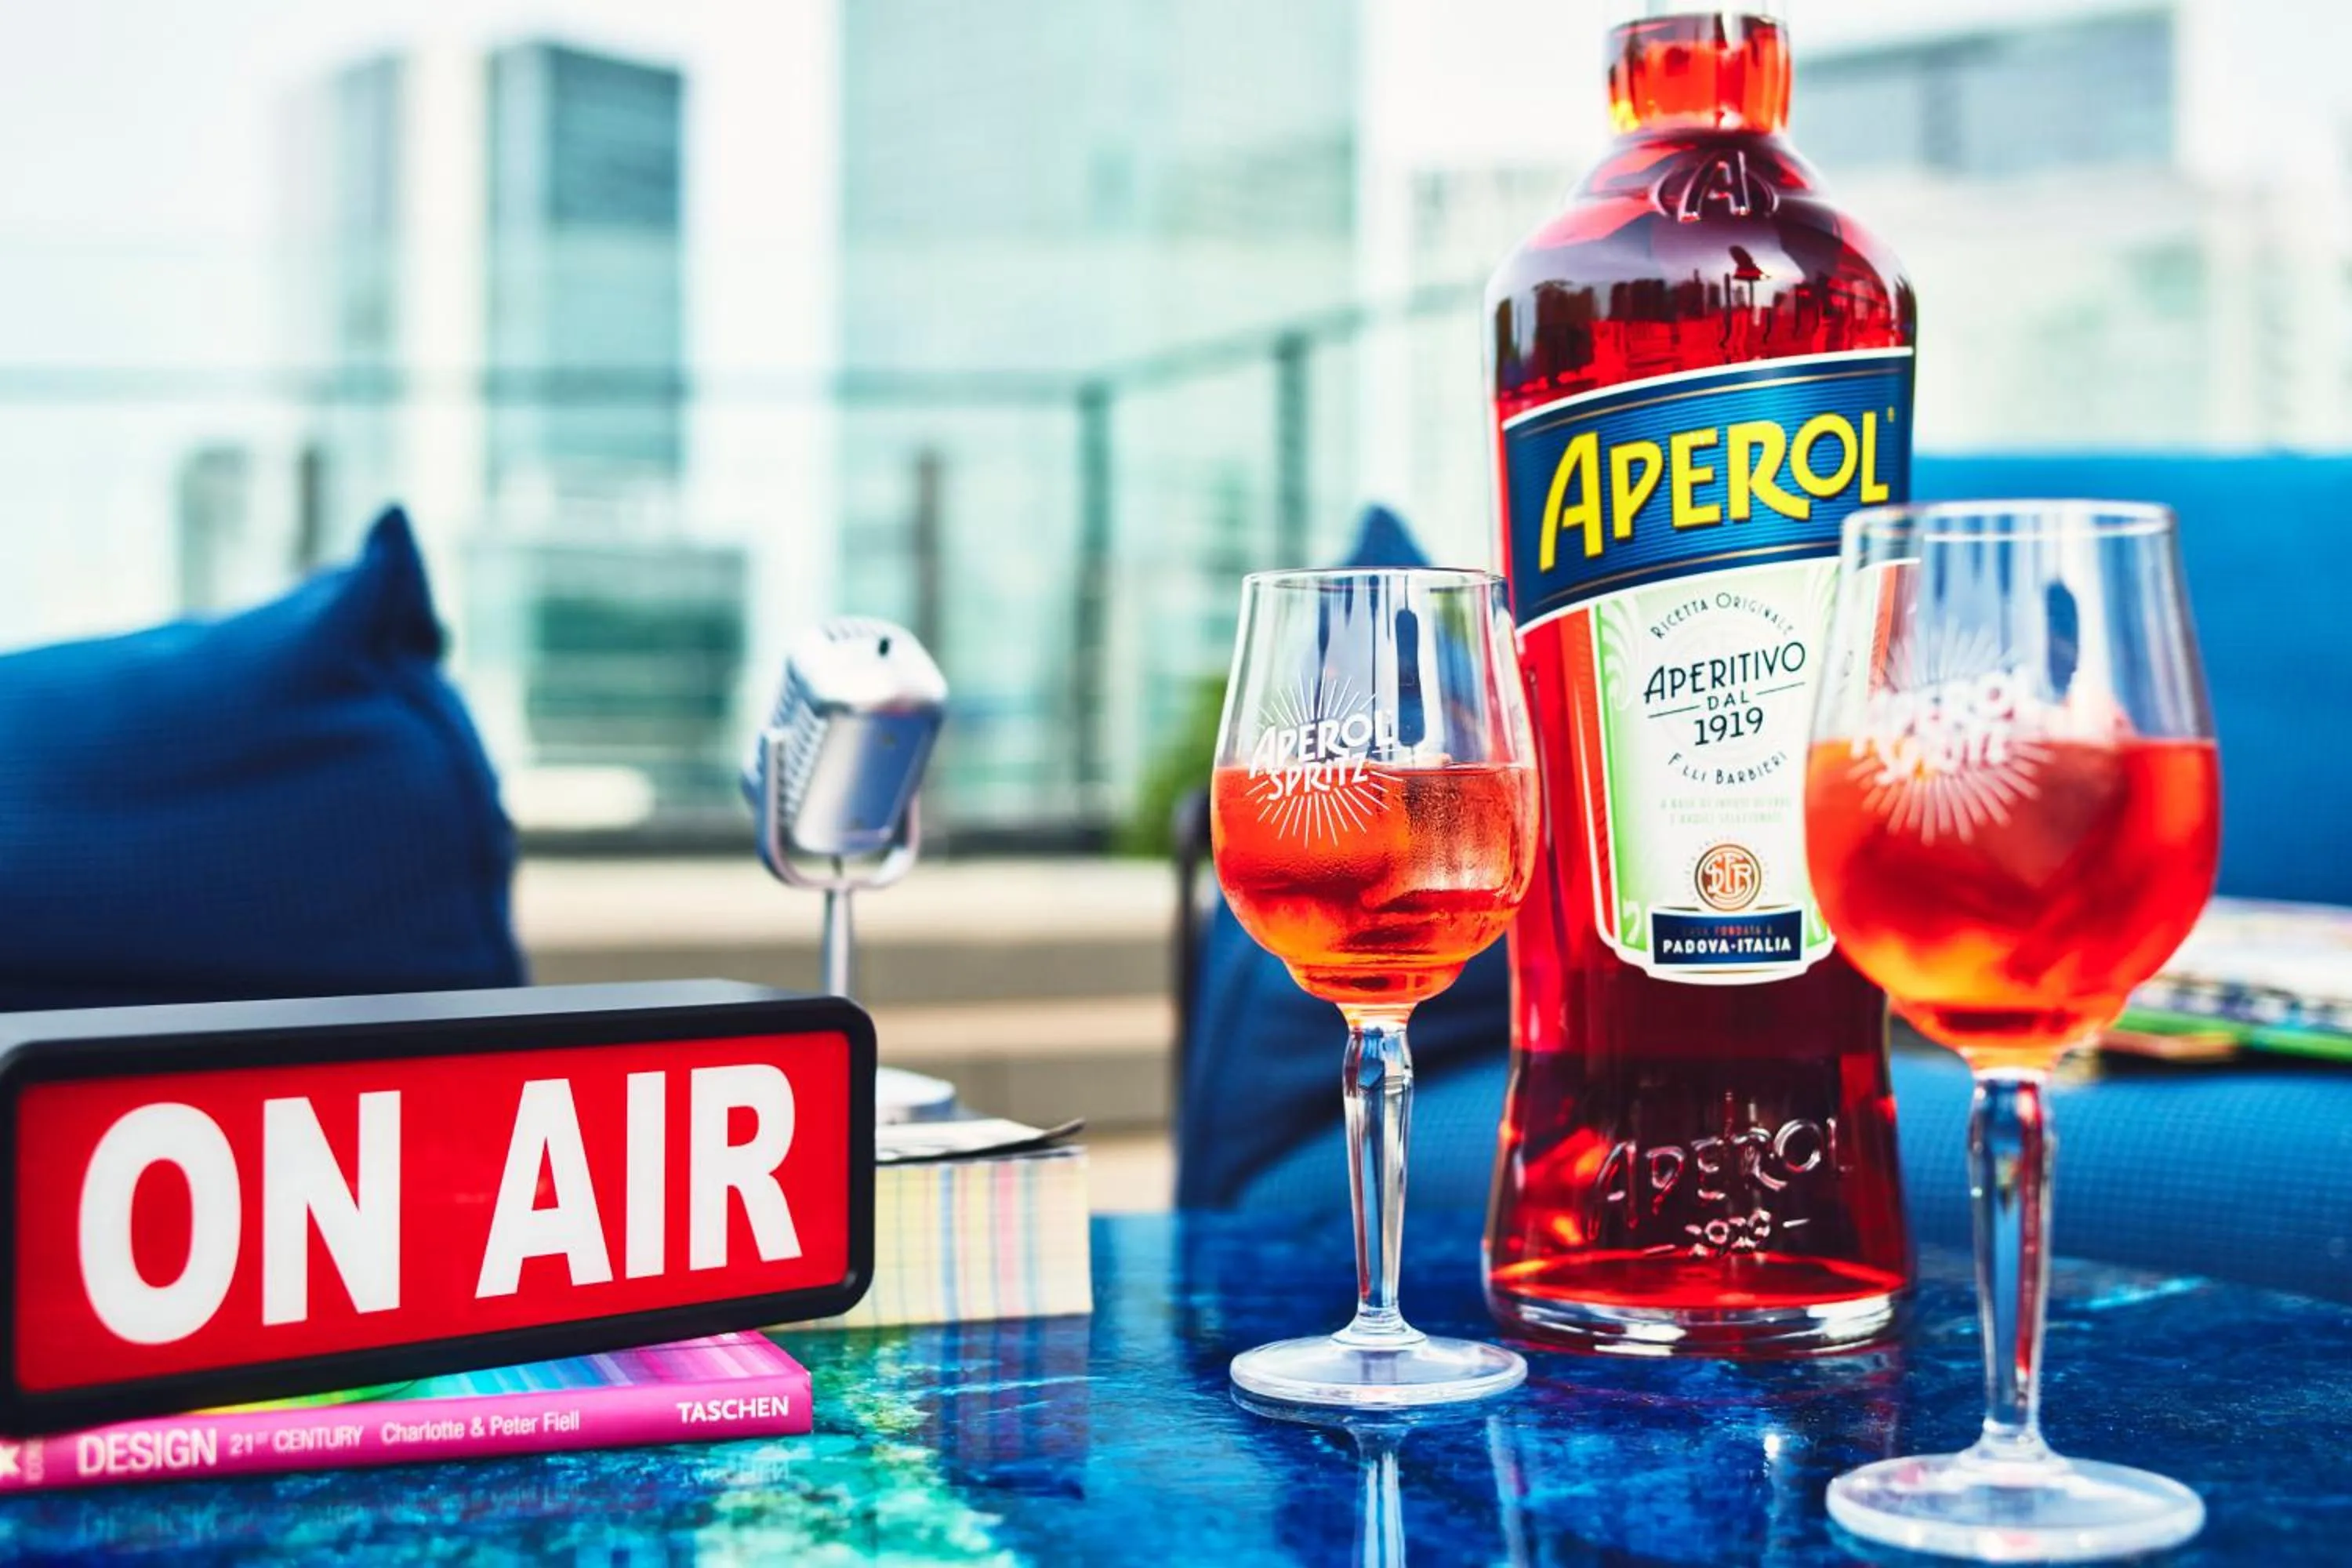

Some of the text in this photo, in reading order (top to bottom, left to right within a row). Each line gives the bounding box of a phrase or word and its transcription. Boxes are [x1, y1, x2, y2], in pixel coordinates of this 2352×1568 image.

[1539, 411, 1889, 573] APEROL
[1650, 592, 1795, 639] RICETTA ORIGINALE
[1643, 641, 1806, 704] APERITIVO
[1707, 690, 1751, 711] DAL
[1248, 708, 1394, 779] APEROL
[1694, 706, 1764, 746] 1919
[1266, 751, 1369, 800] SPRITZ
[1715, 750, 1789, 785] BARBIERI
[78, 1063, 803, 1346] ON AIR
[78, 1428, 217, 1477] DESIGN
[274, 1425, 365, 1452] CENTURY
[380, 1420, 465, 1444] Charlotte
[470, 1415, 485, 1439] &
[490, 1414, 539, 1436] Peter
[543, 1409, 580, 1432] Fiell
[676, 1396, 789, 1425] TASCHEN
